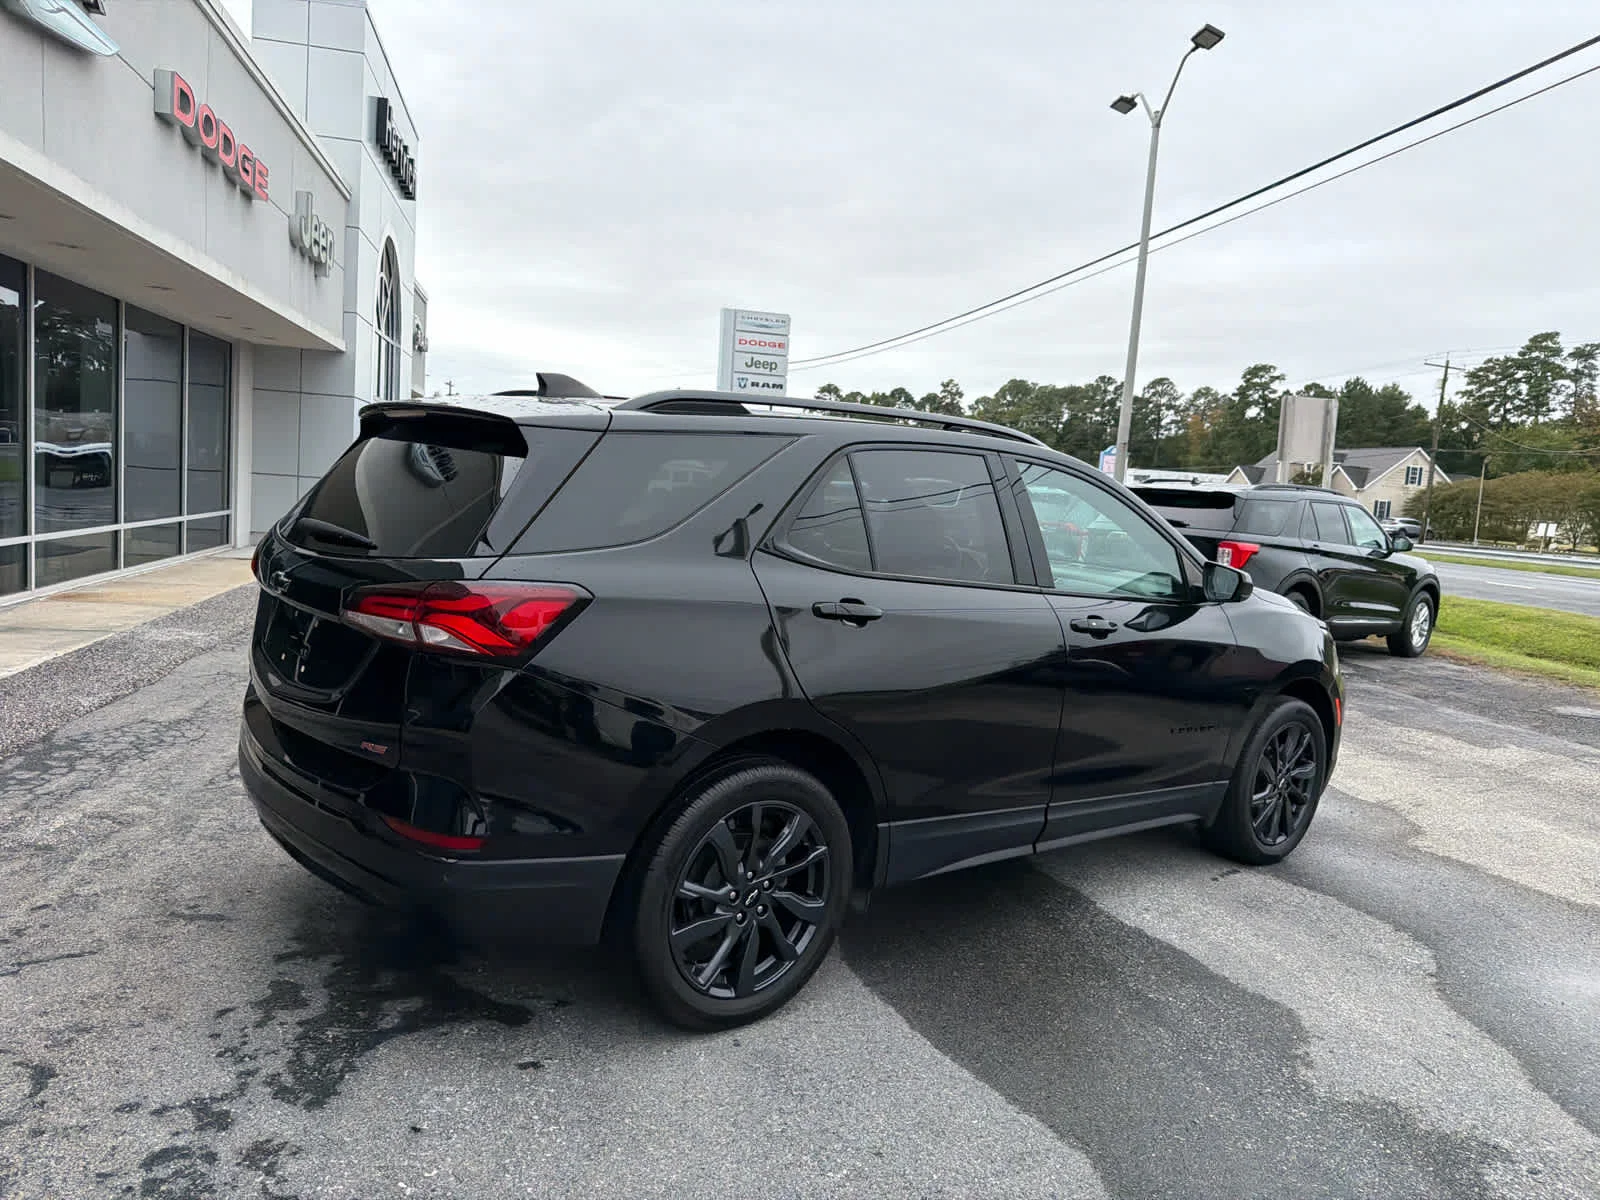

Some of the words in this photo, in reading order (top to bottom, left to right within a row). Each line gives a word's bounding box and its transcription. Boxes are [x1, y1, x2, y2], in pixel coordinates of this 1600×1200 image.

[172, 71, 269, 202] DODGE
[299, 191, 335, 278] Jeep
[738, 338, 786, 349] DODGE
[744, 356, 778, 372] Jeep
[750, 381, 784, 389] RAM
